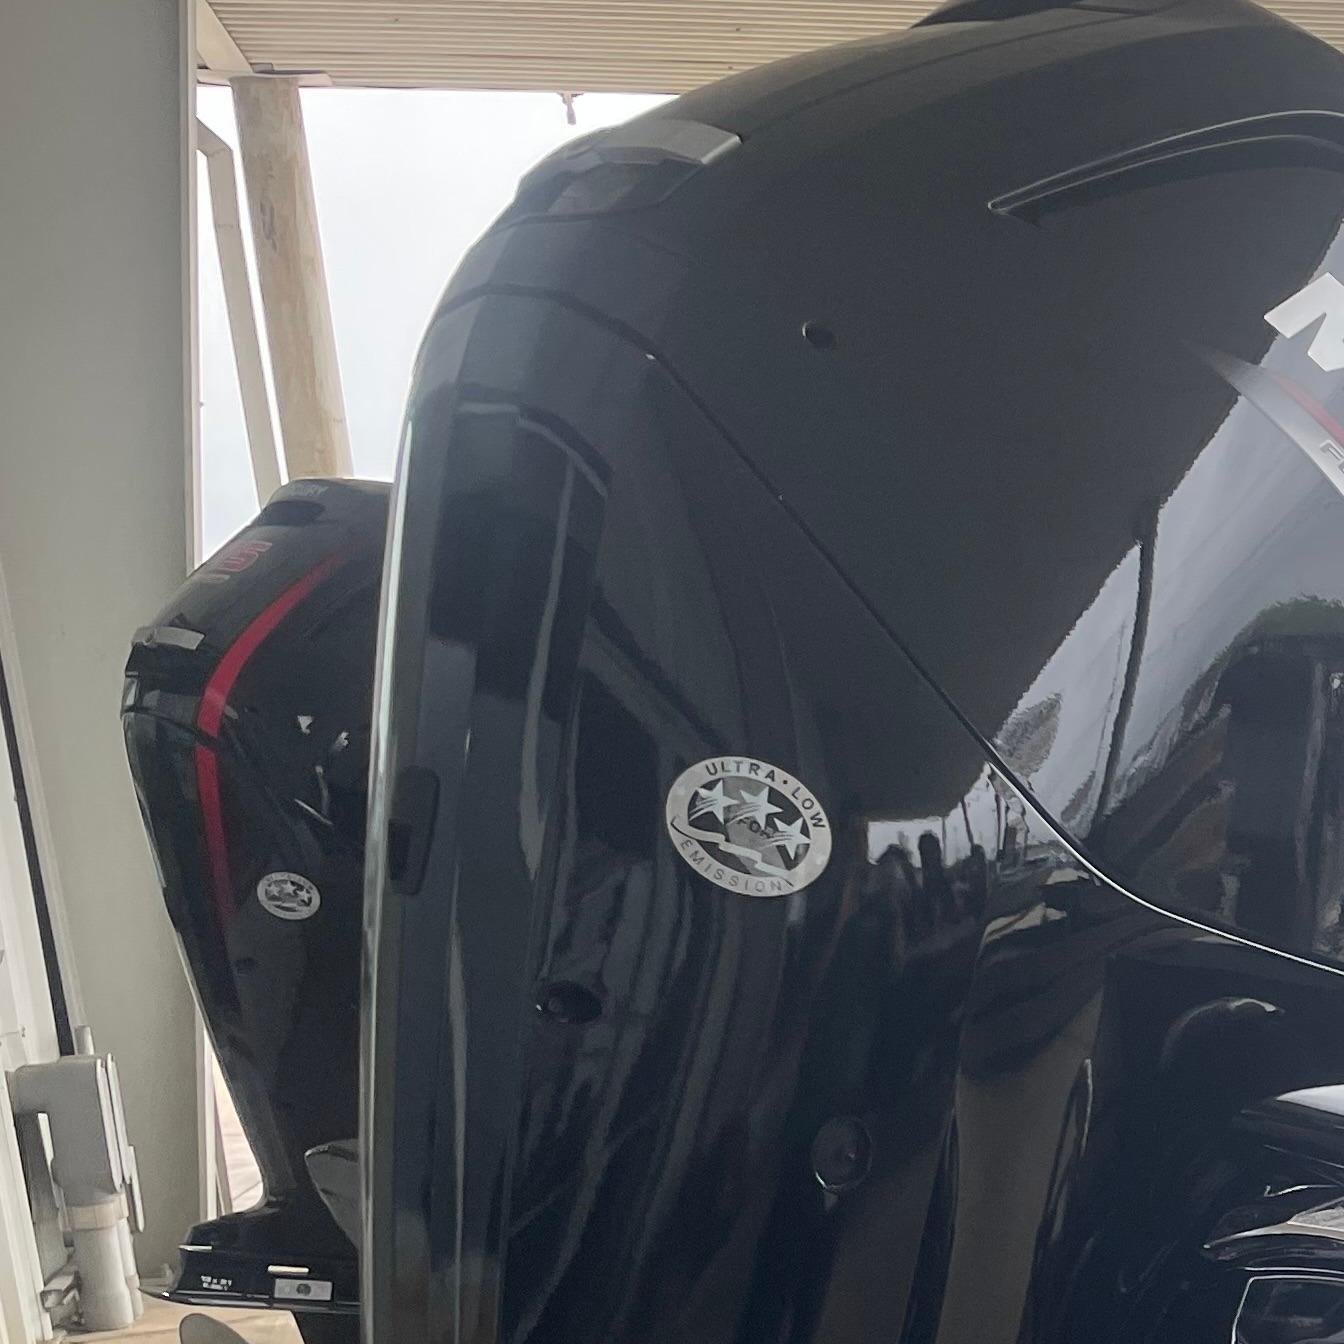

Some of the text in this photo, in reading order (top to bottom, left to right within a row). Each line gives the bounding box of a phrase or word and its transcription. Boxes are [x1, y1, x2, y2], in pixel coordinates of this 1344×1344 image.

[706, 761, 826, 829] ULTRA LOW
[680, 838, 783, 893] EMISSION
